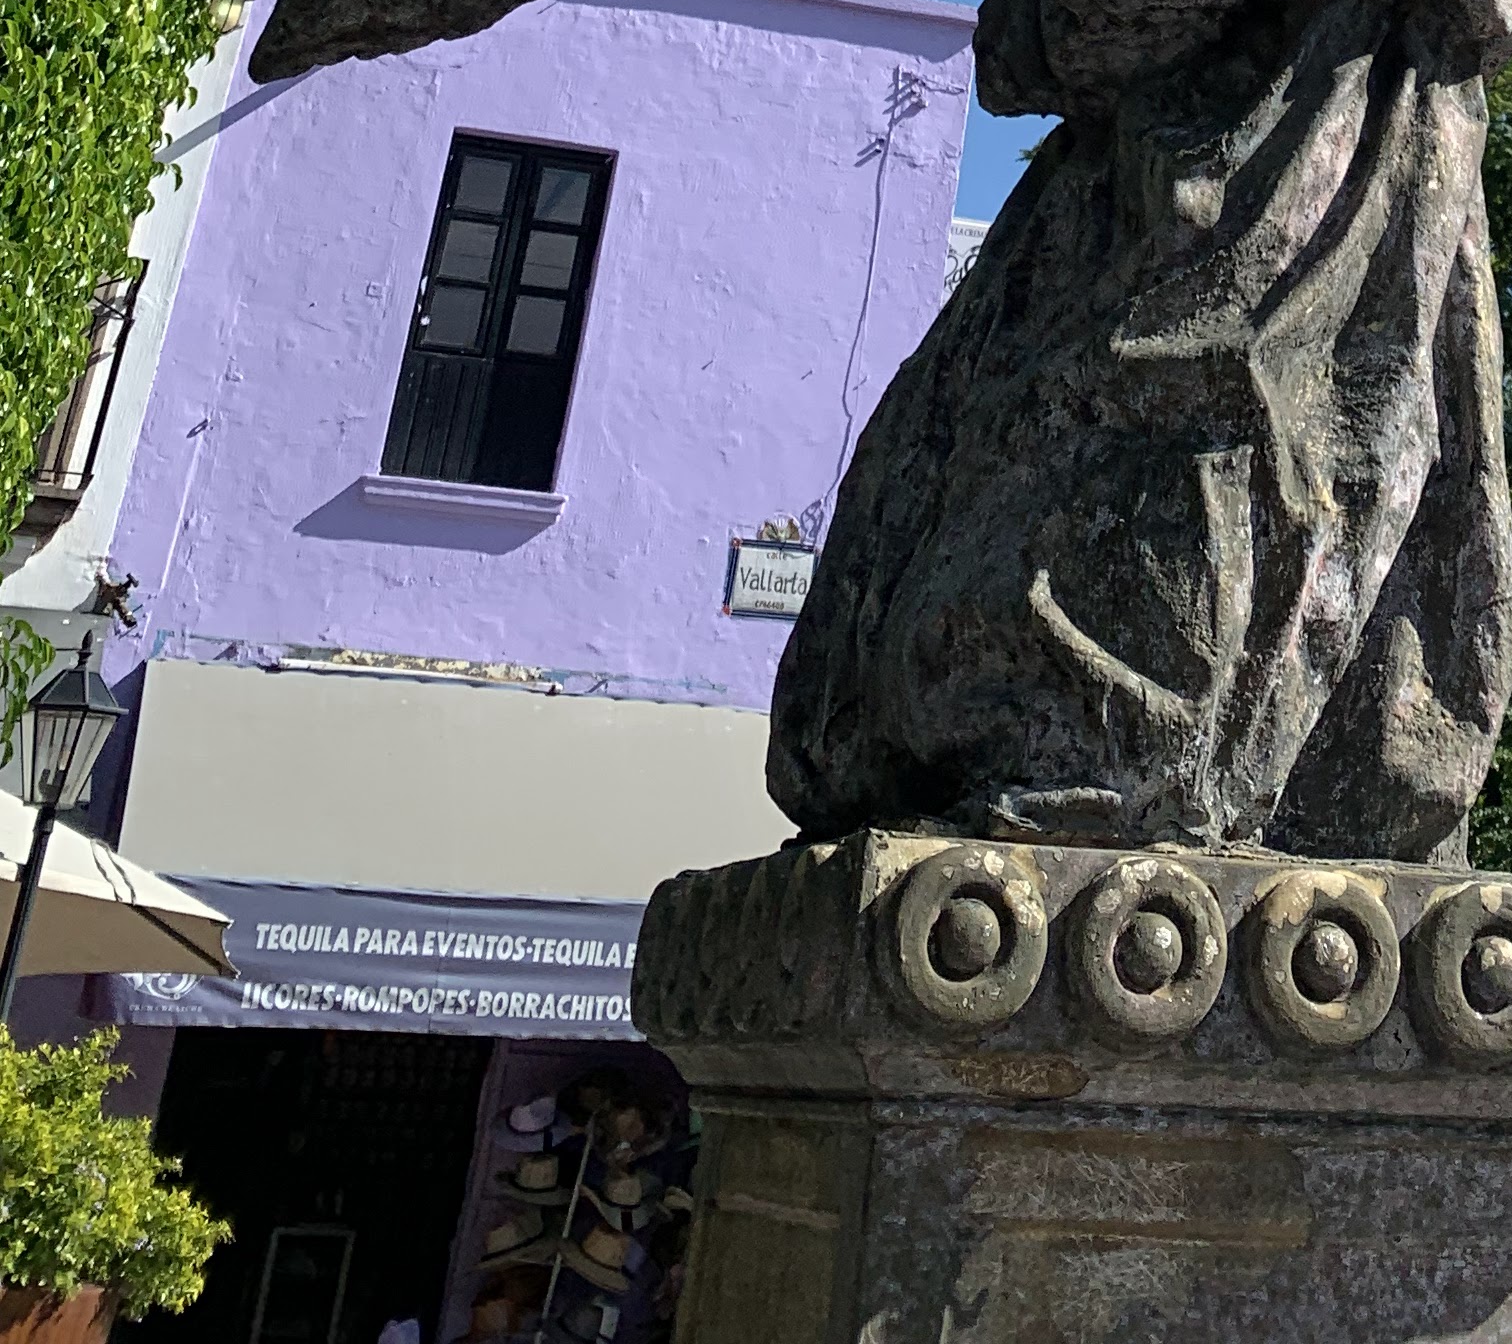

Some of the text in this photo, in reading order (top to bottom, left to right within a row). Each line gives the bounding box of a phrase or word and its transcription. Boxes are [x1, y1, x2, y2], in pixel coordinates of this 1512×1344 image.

[740, 566, 808, 596] Vallarta
[255, 922, 350, 954] TEQUILA
[353, 926, 418, 956] PARA
